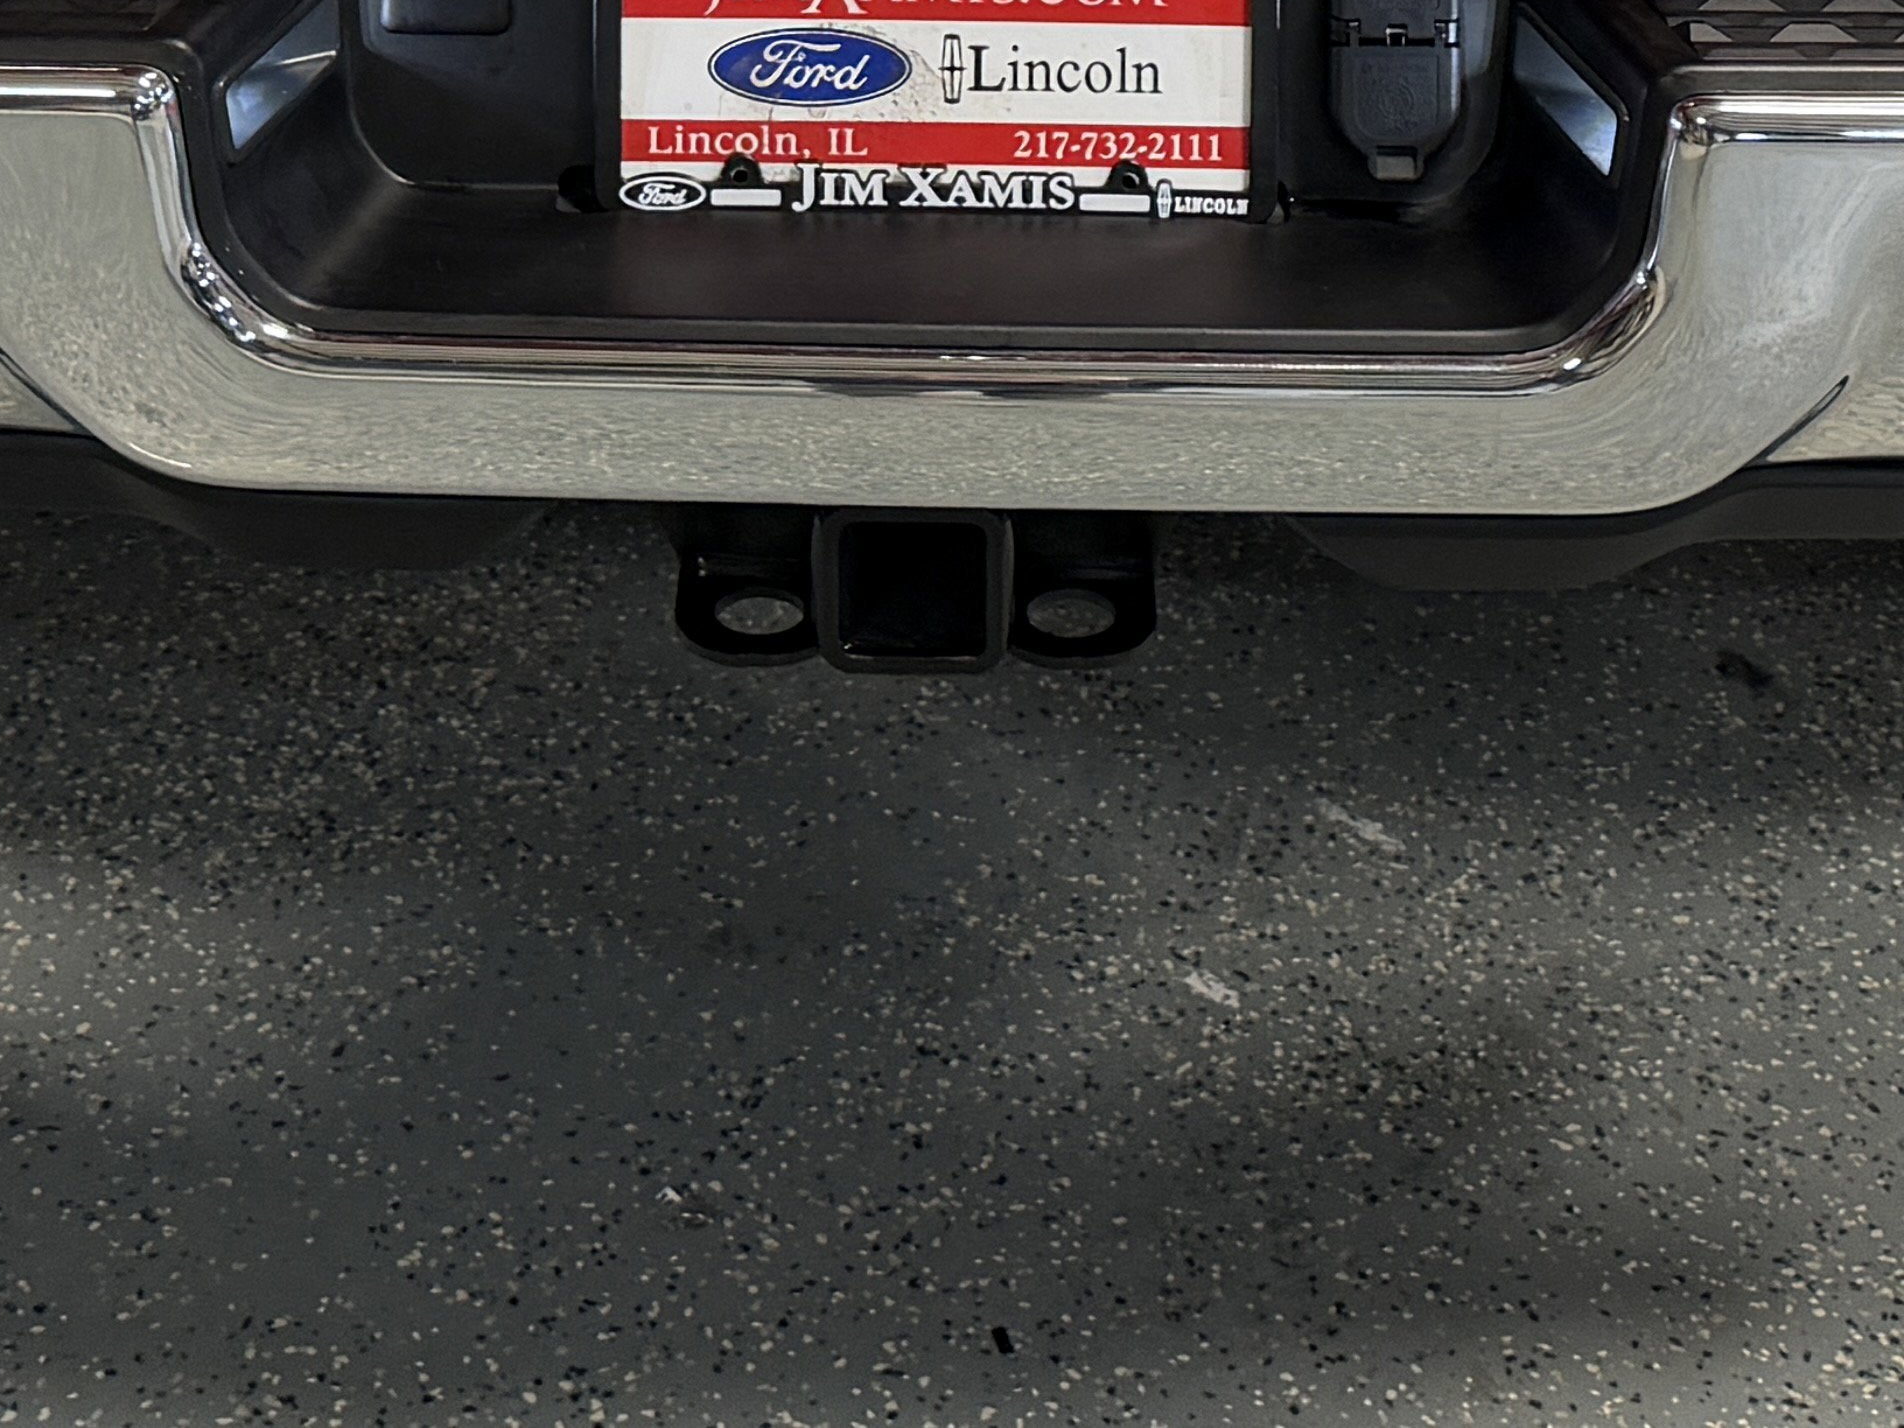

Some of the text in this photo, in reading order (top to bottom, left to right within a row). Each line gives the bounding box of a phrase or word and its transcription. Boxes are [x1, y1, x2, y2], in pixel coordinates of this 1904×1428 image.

[749, 39, 870, 91] Ford
[967, 44, 1163, 94] Lincoln
[647, 125, 868, 159] Lincoln, IL
[1013, 130, 1223, 161] 217-732-2111
[638, 182, 688, 205] Ford
[791, 162, 1076, 212] JIM XAMIS
[1175, 196, 1250, 215] LINCOLN
